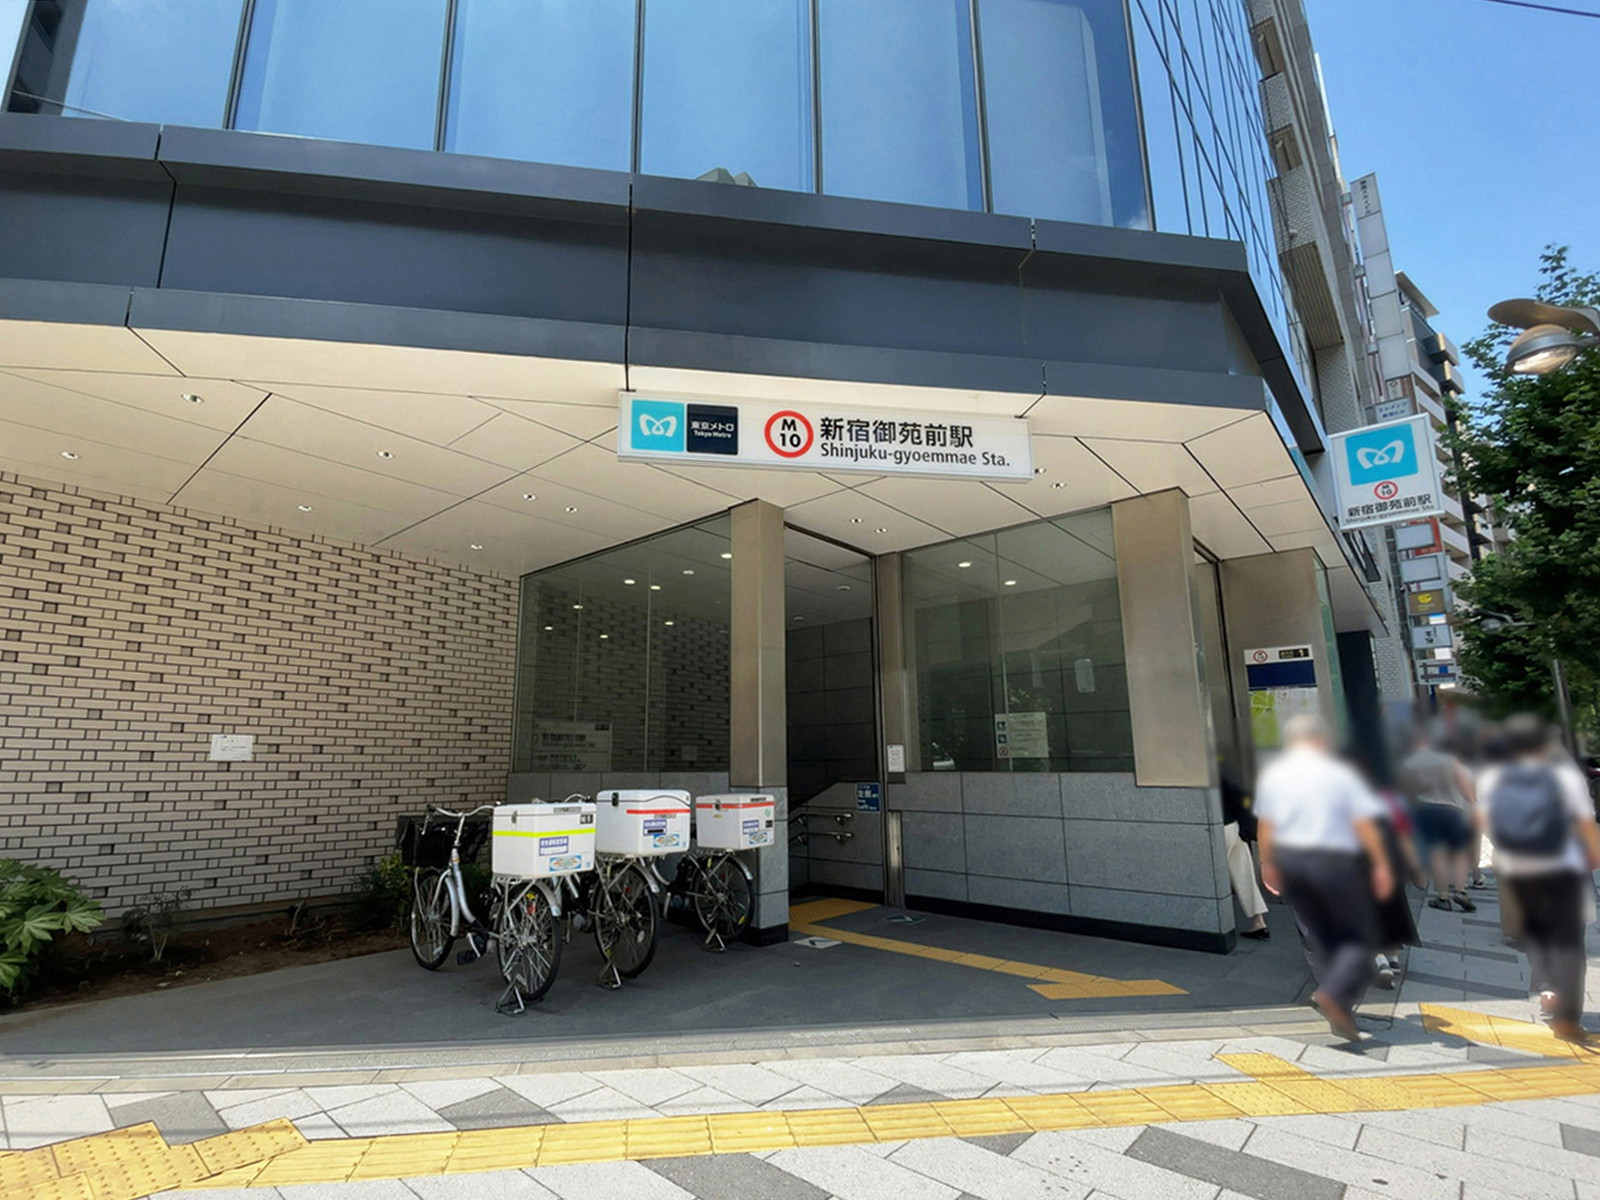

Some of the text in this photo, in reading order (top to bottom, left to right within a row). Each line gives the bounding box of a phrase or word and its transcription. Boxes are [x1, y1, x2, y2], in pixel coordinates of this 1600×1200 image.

[691, 420, 735, 432] 東京メトロ
[781, 418, 797, 432] M
[820, 416, 974, 448] 新宿御苑前駅
[694, 429, 712, 438] Tokyo
[780, 433, 801, 448] 10
[820, 442, 1010, 467] Shinjuku-gyoemmae Sta.
[1347, 494, 1432, 517] 新宿御苑前駅
